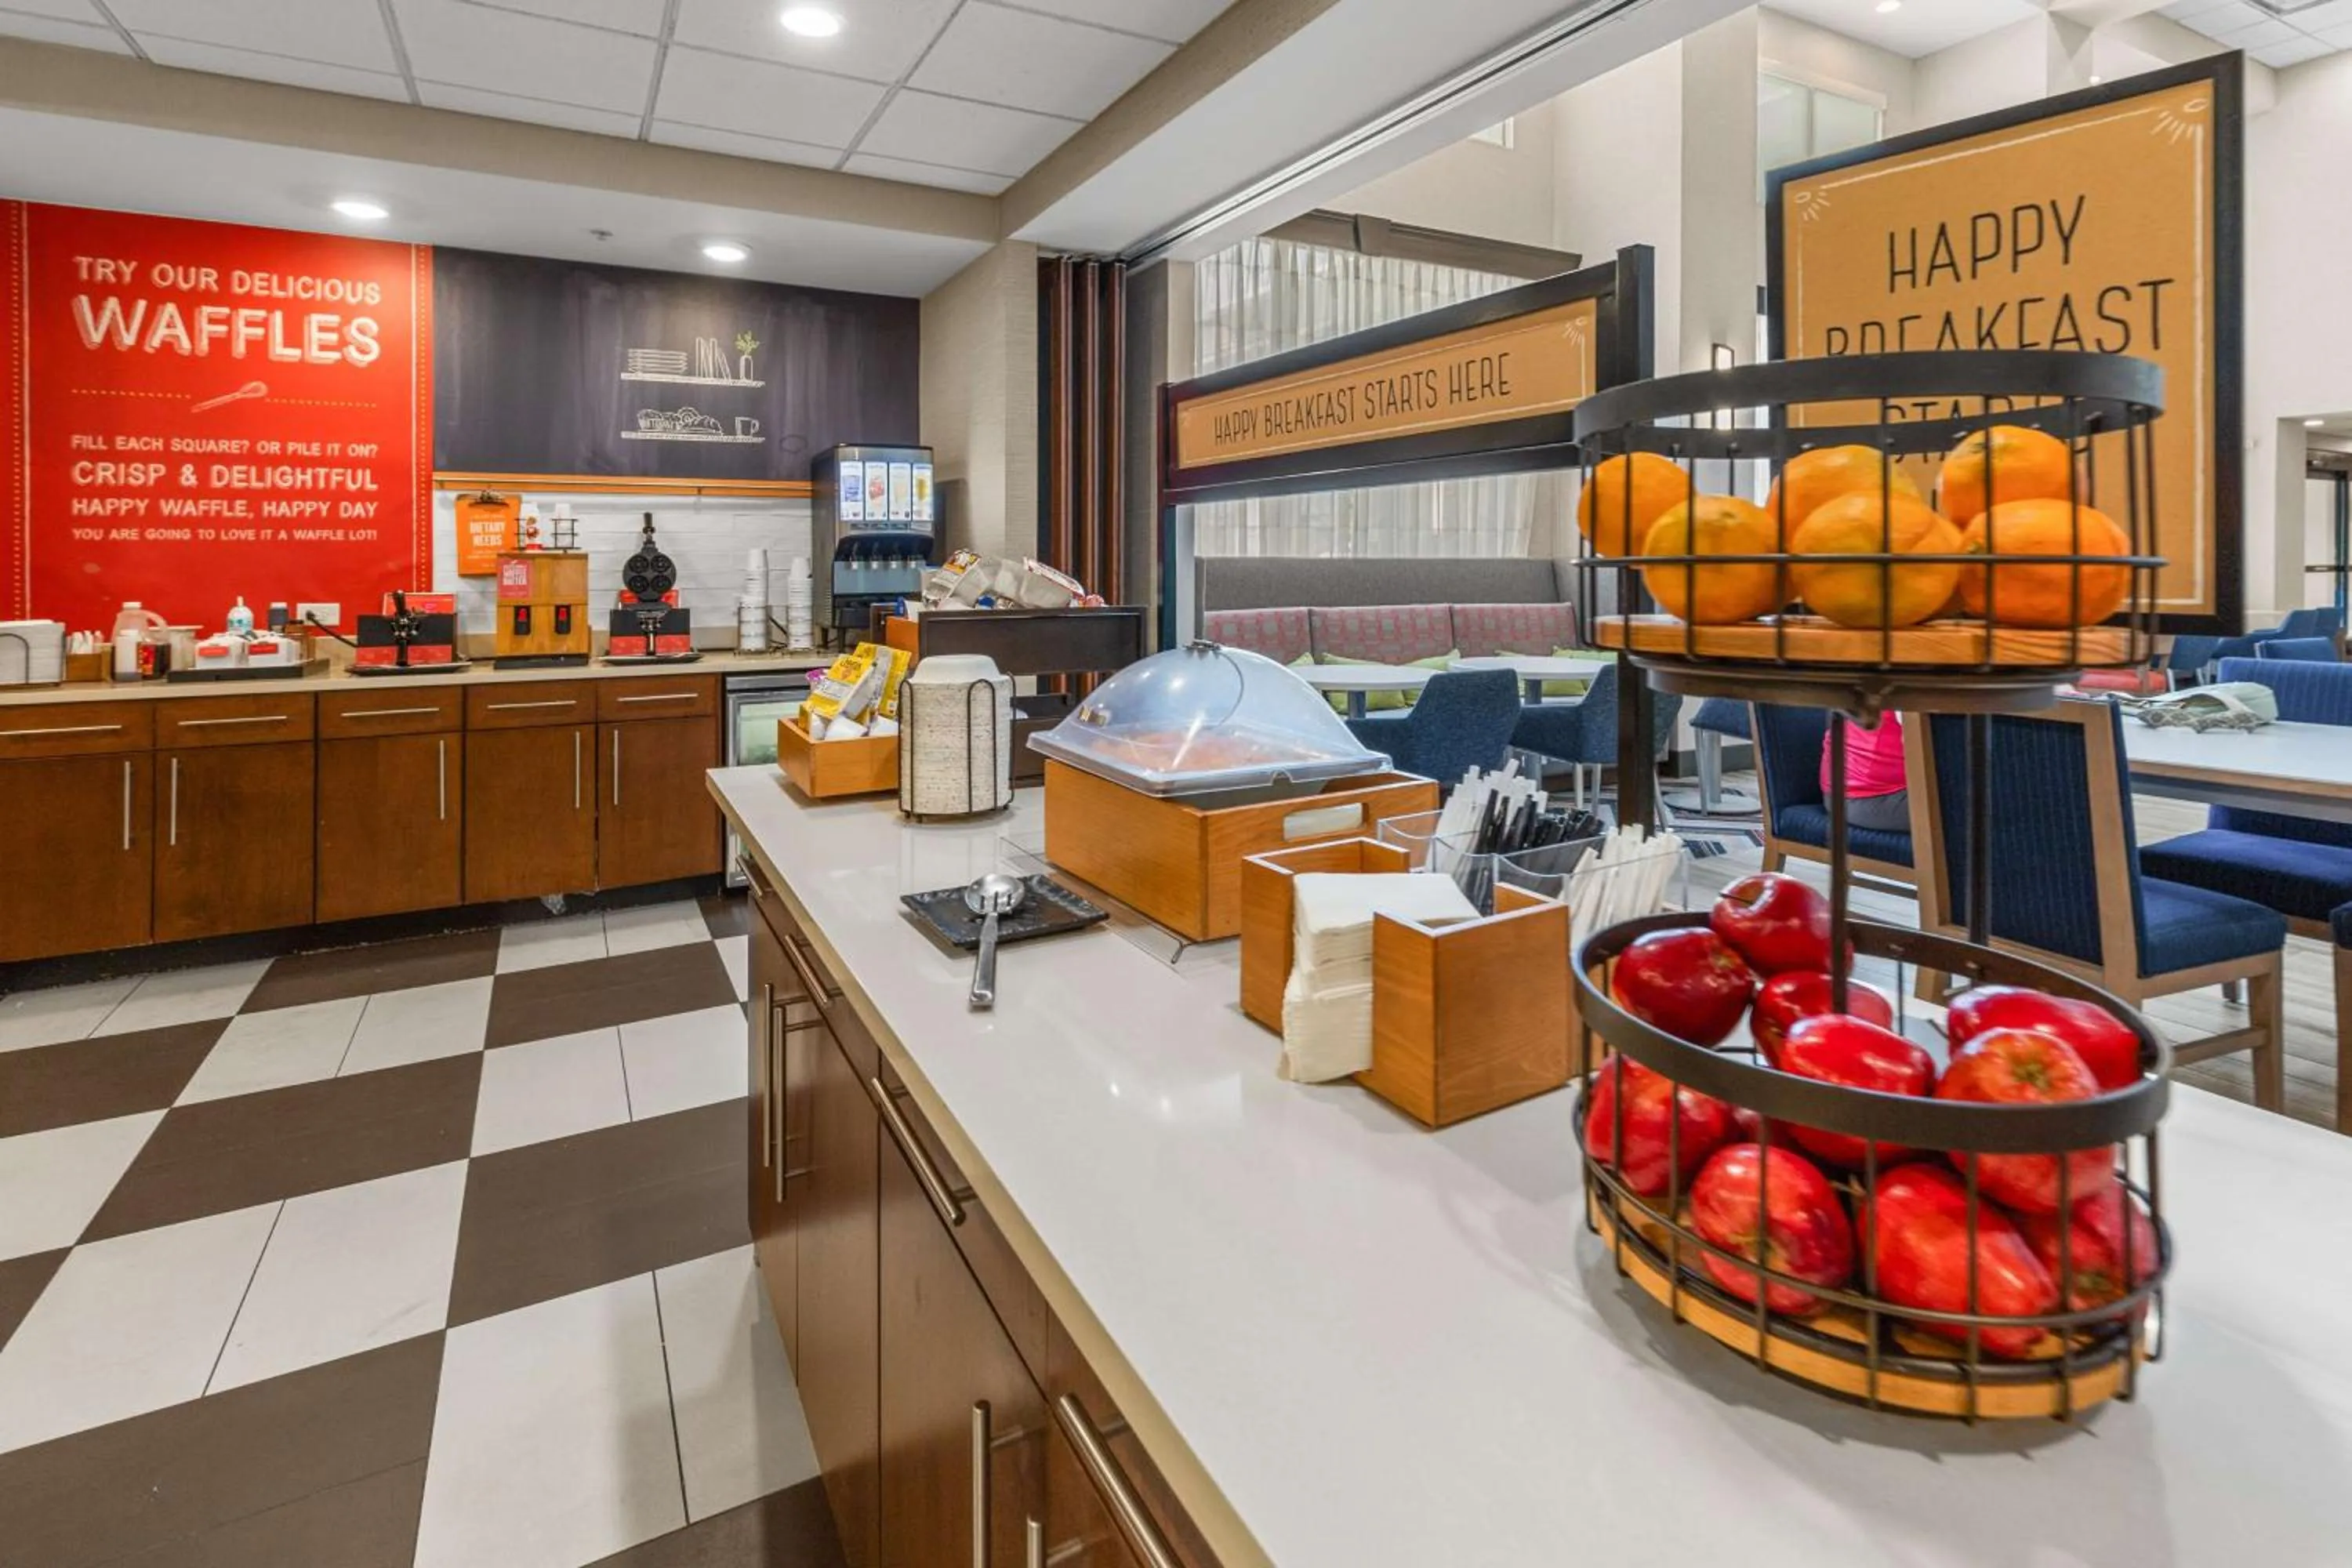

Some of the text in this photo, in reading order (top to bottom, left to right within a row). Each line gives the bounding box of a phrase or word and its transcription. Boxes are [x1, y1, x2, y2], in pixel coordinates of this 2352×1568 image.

[1888, 194, 2086, 294] HAPPY
[72, 256, 381, 306] TRY OUR DELICIOUS
[72, 294, 381, 367] WAFFLES
[1214, 352, 1512, 446] HAPPY BREAKFAST STARTS HERE
[71, 434, 379, 459] FILL EACH SQUARE? OR PILE IT ON?
[72, 461, 379, 492] CRISP & DELIGHTFUL
[72, 498, 378, 520] HAPPY WAFFLE, HAPPY DAY
[72, 528, 103, 541] YOU
[109, 528, 140, 541] ARE
[144, 528, 191, 541] GOING
[197, 528, 216, 541] TO
[220, 529, 256, 541] LOVE
[260, 529, 274, 541] IT
[278, 529, 288, 541] A
[293, 529, 345, 541] WAFFLE
